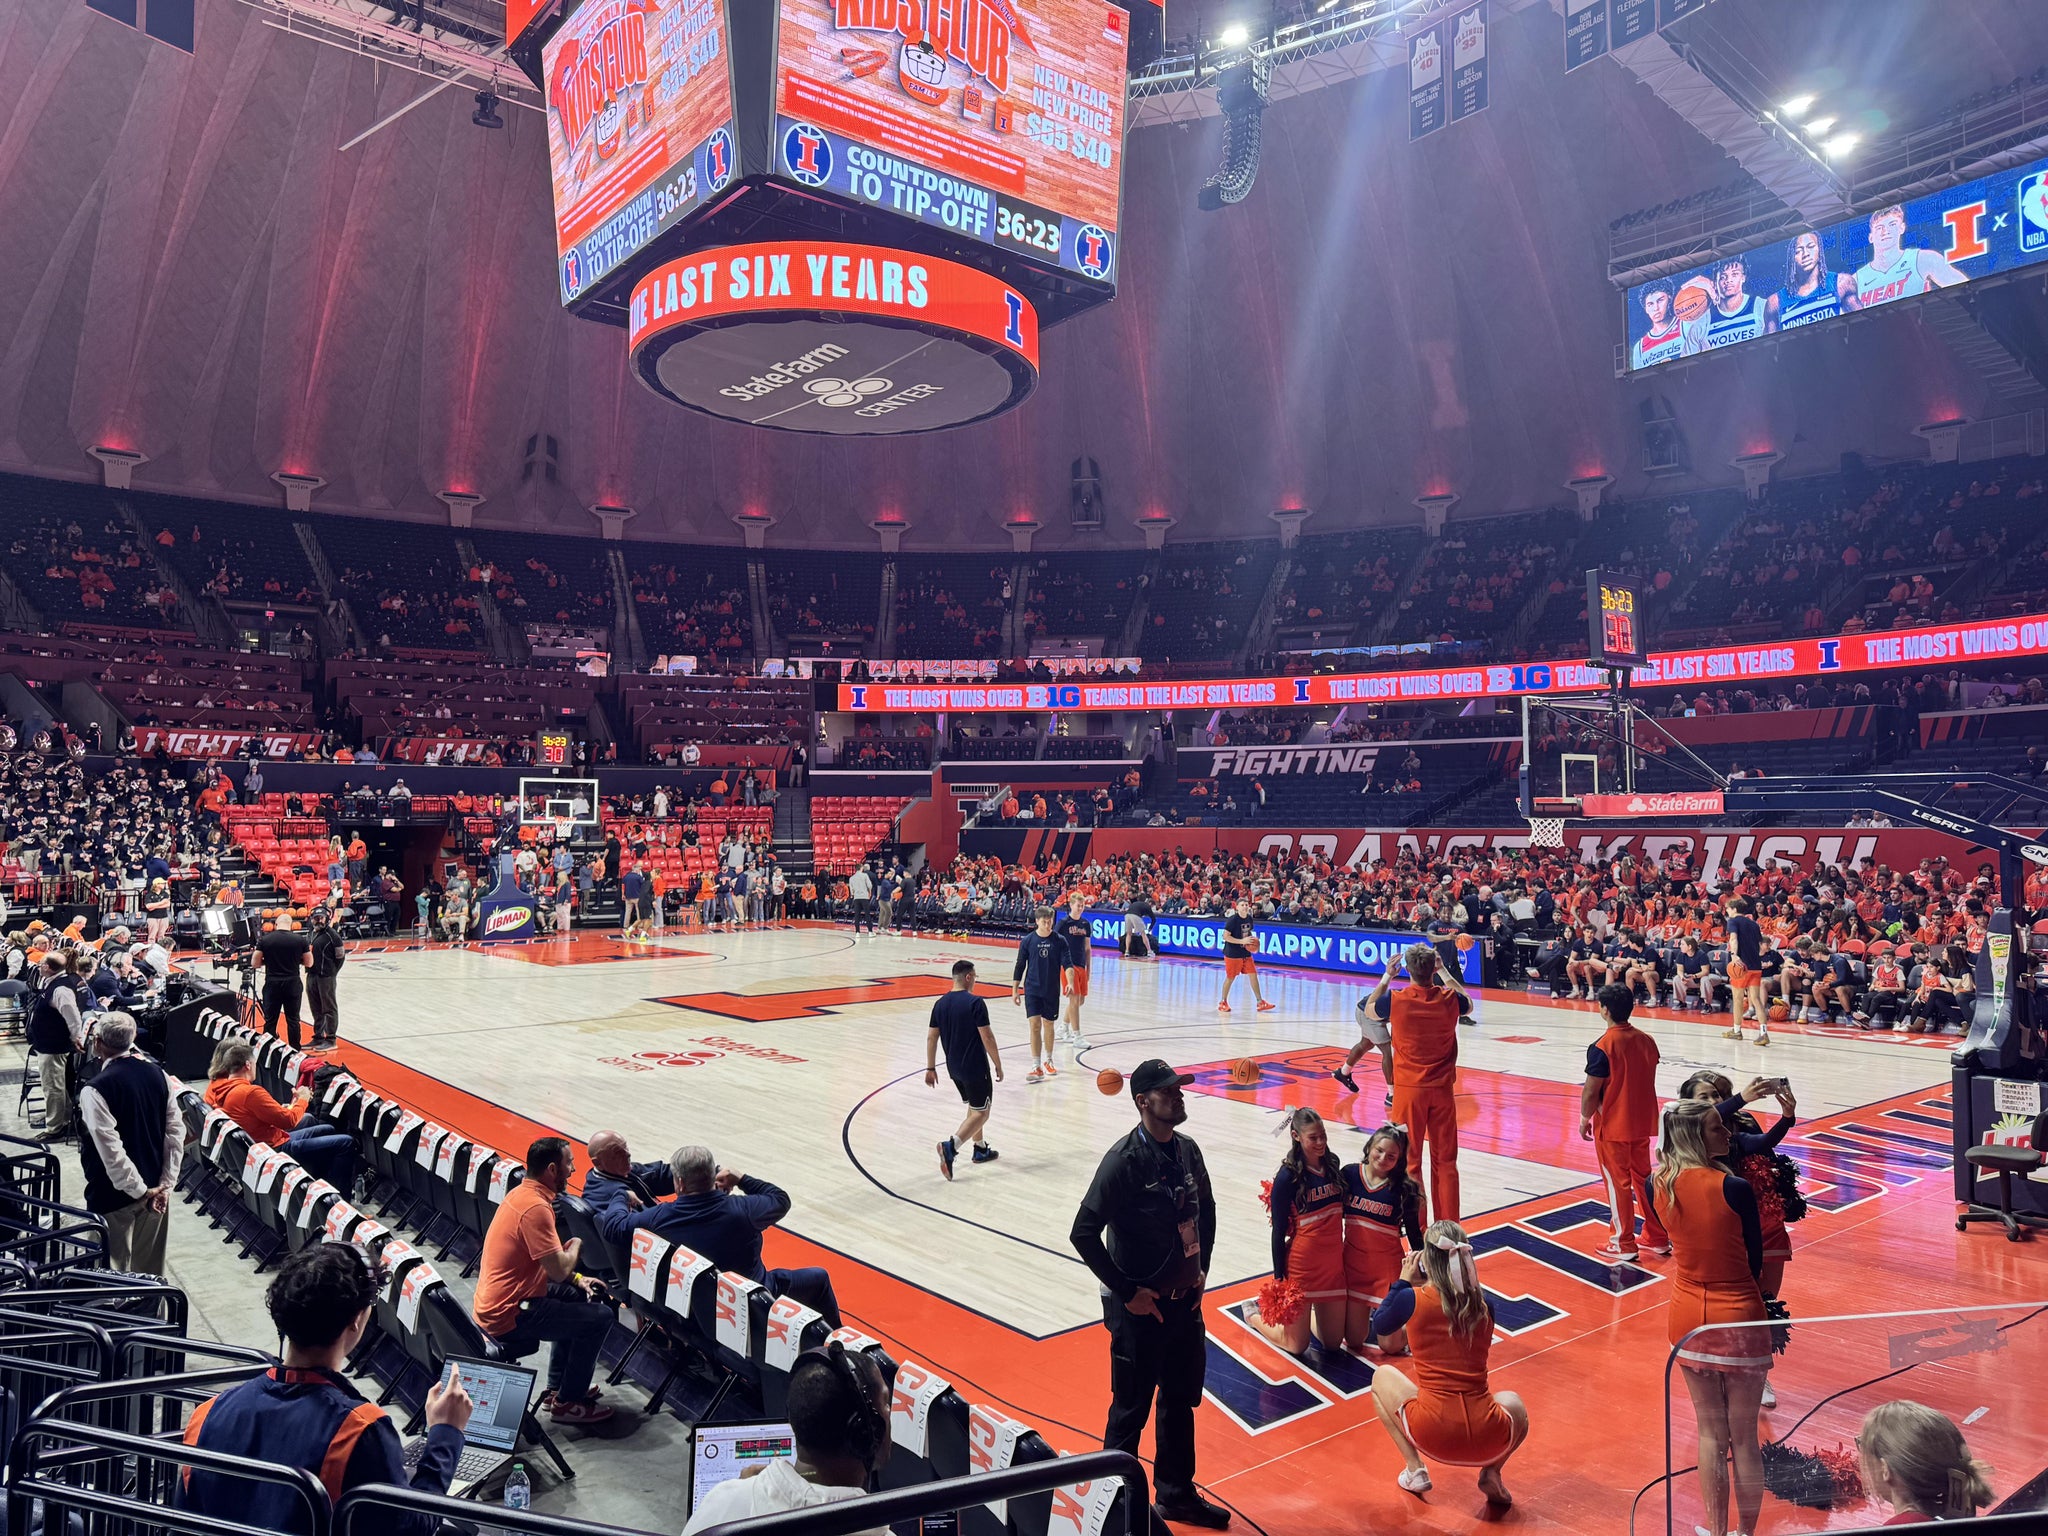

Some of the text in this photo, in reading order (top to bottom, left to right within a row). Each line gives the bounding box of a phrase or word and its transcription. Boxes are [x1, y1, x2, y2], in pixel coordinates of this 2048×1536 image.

[660, 5, 682, 39] NEW
[661, 1, 715, 63] NEW PRICE
[1579, 10, 1592, 23] DON
[689, 27, 718, 76] $40
[926, 0, 1011, 95] CLUB
[1462, 35, 1476, 50] 33
[1420, 57, 1433, 71] 40
[1463, 67, 1475, 78] BILL
[565, 40, 602, 156] KIDS
[601, 12, 648, 92] CLUB
[1034, 63, 1113, 116] NEW YEAR,
[1033, 86, 1112, 133] NEW PRICE
[1027, 112, 1071, 150] $55
[1071, 129, 1112, 169] $40
[656, 167, 698, 221] 36:23
[846, 145, 989, 210] COUNTDOWN
[847, 165, 988, 237] TO TIP-OFF
[586, 190, 653, 256] COUNTDOWN
[997, 207, 1060, 253] 36:23
[2026, 231, 2046, 247] NBA
[586, 210, 653, 281] TO TIP-OFF
[653, 262, 718, 320] LAST
[729, 254, 791, 299] SIX
[806, 255, 929, 308] YEARS
[1861, 271, 1913, 307] HEAT
[1707, 329, 1755, 347] WOLVES
[1782, 307, 1836, 331] MINNESOTA
[854, 383, 944, 418] CENTER
[1601, 584, 1634, 613] 36:23
[1606, 613, 1633, 653] 30
[884, 690, 905, 708] THE
[905, 689, 949, 708] MOST
[950, 689, 986, 708] WINS
[987, 689, 1022, 707] OVER
[1084, 687, 1128, 706] TEAMS
[1130, 687, 1144, 706] IN
[1146, 686, 1168, 706] THE
[1170, 685, 1205, 705] LAST
[1207, 684, 1230, 704] SIX
[1231, 682, 1276, 703] YEARS
[1329, 678, 1354, 699] THE
[1357, 676, 1397, 698] MOST
[1400, 673, 1445, 696] WINS
[1446, 671, 1482, 693] OVER
[1662, 653, 1705, 679] LAST
[1707, 650, 1738, 676] SIX
[1739, 648, 1795, 674] YEARS
[1865, 638, 1902, 664] THE
[1903, 631, 1960, 661] MOST
[1961, 625, 2018, 655] WINS
[542, 736, 567, 747] 36:23
[545, 746, 564, 763] 30
[1210, 748, 1380, 778] FIGHTING
[1912, 808, 1975, 834] LEGACY
[486, 911, 527, 932] LIBMAN
[1158, 924, 1226, 950] BURGE
[1251, 931, 1332, 963] HAPPY
